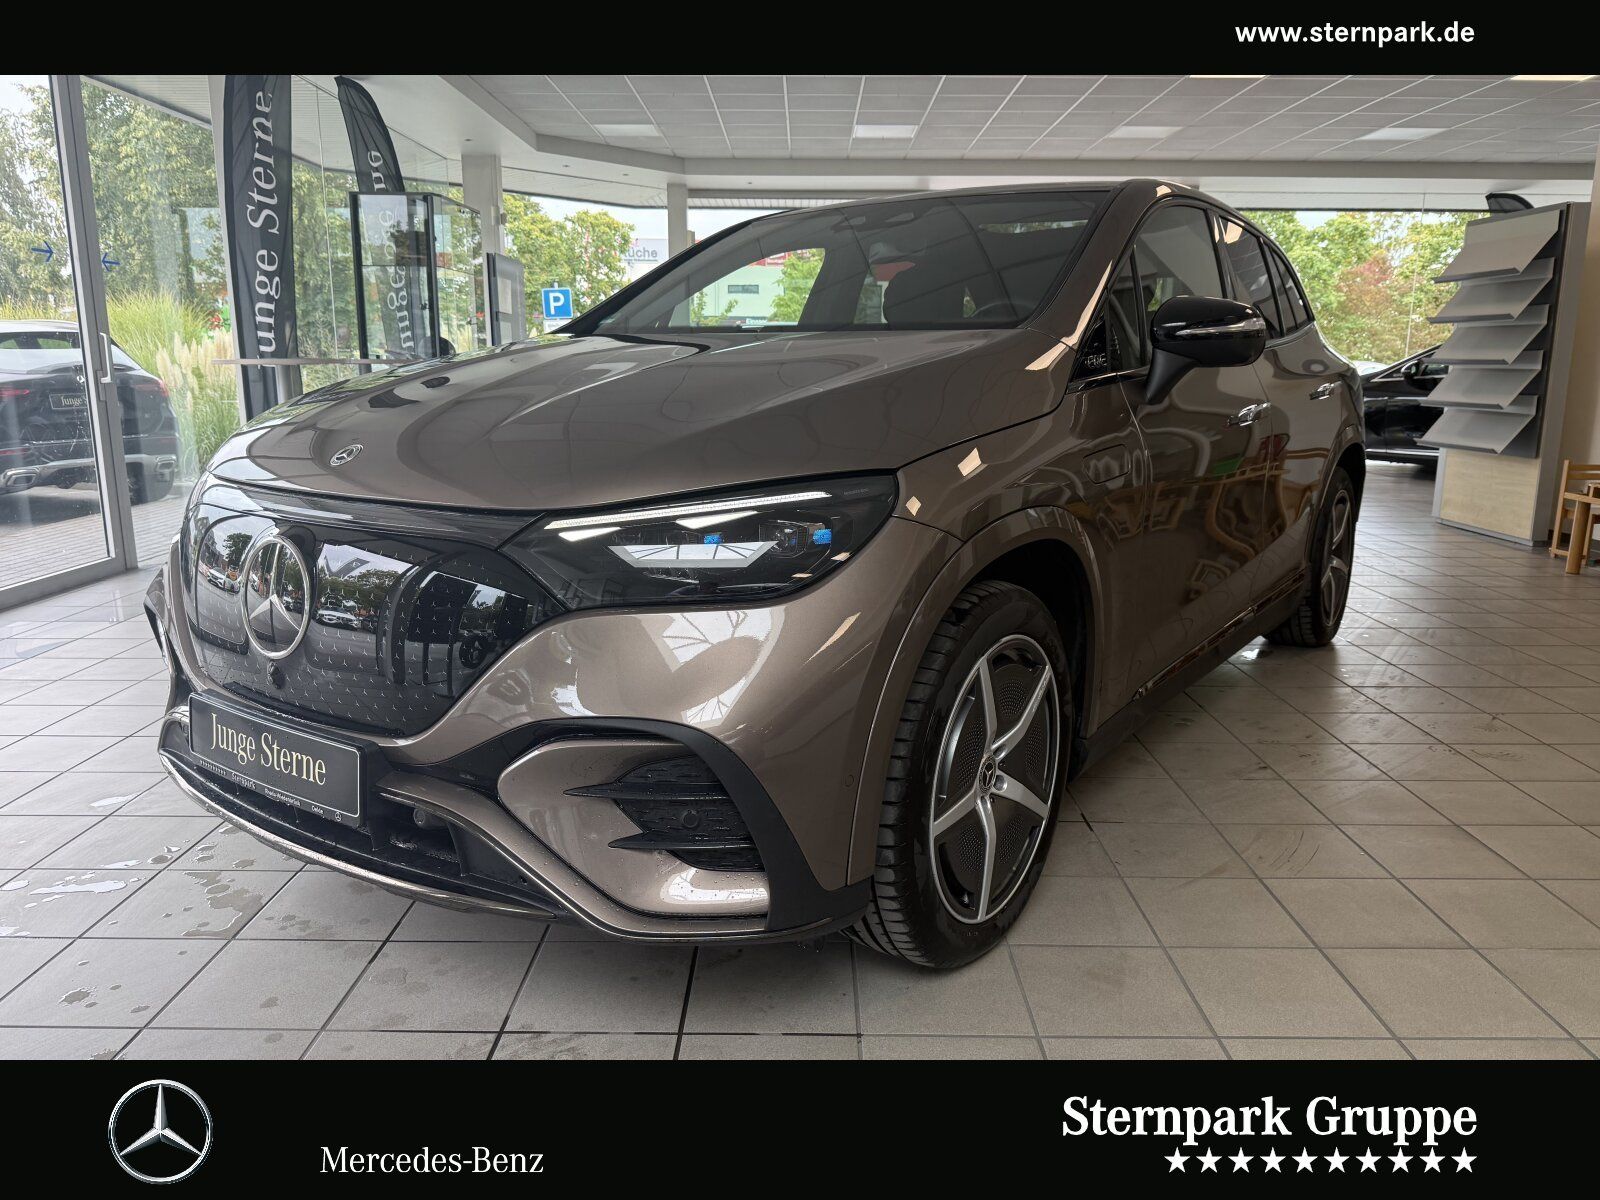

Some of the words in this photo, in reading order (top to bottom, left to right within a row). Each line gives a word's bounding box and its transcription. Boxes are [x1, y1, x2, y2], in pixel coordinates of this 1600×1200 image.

[246, 90, 280, 235] Sterne
[624, 246, 658, 258] üche
[548, 292, 565, 315] P
[61, 395, 83, 407] Junge
[210, 712, 256, 765] Junge
[261, 732, 326, 786] Sterne
